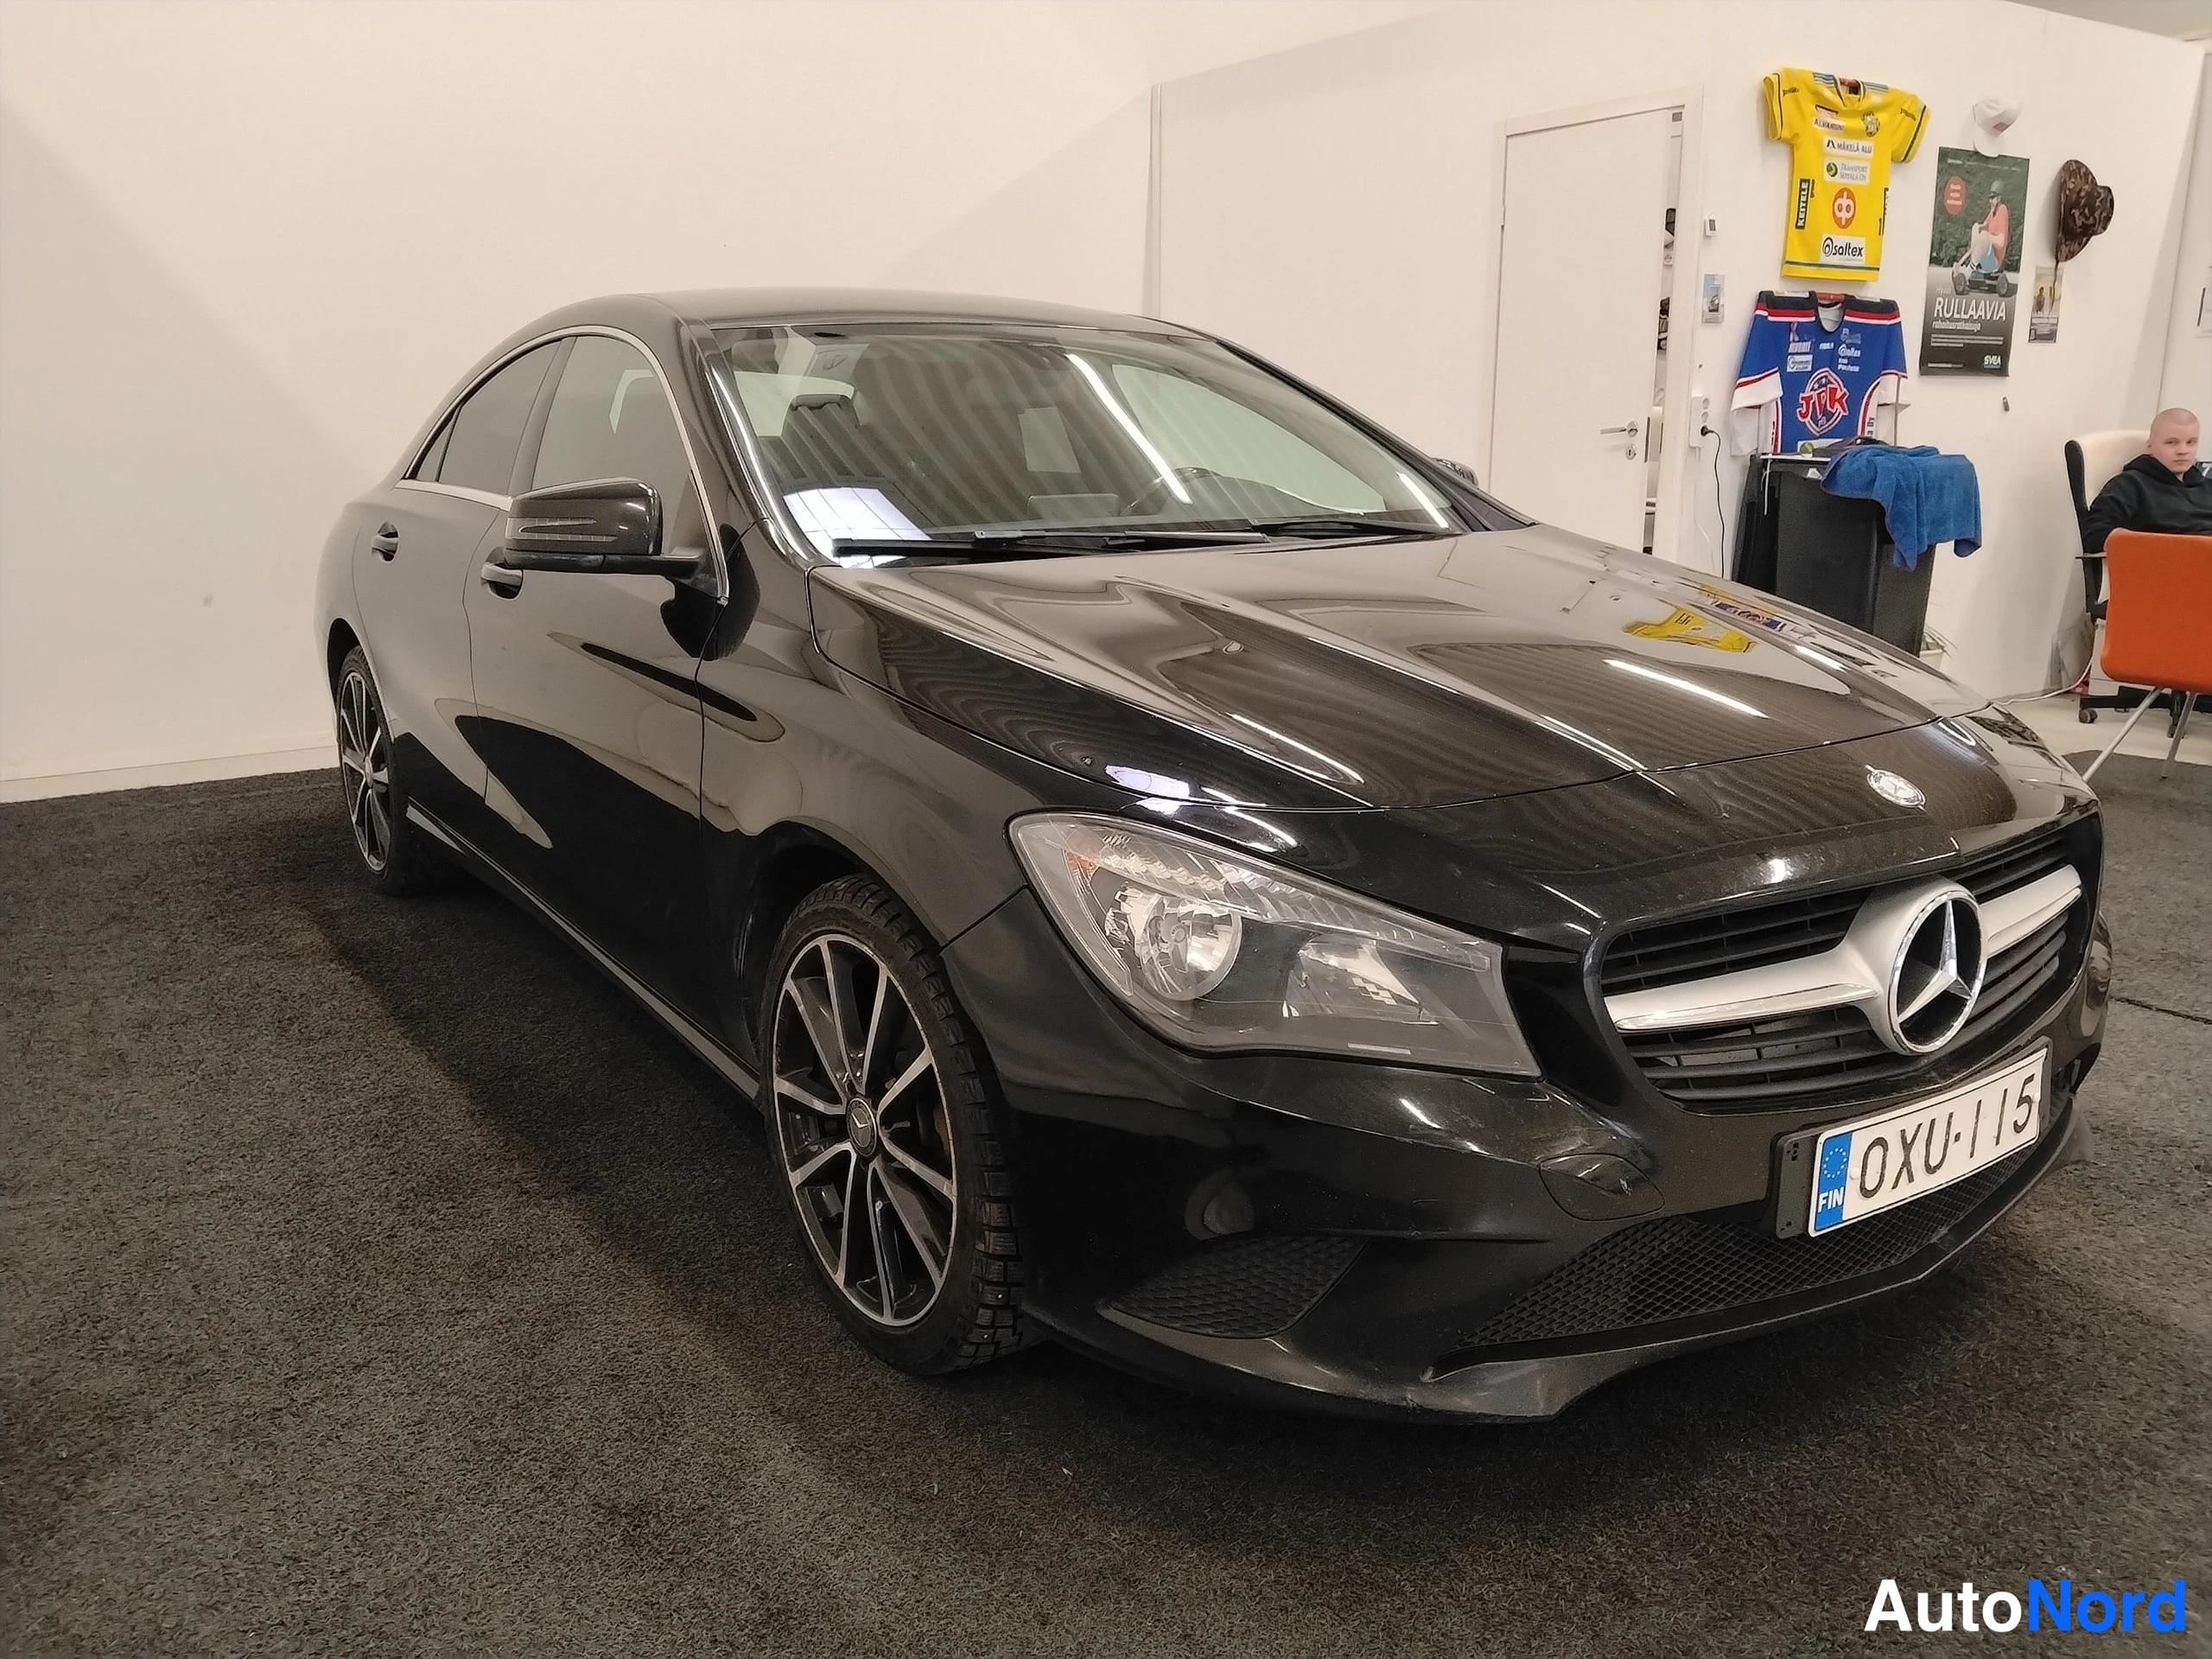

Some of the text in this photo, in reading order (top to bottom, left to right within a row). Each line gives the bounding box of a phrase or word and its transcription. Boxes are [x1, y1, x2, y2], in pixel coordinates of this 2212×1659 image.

[1797, 181, 1809, 227] KEITELE
[1832, 242, 1864, 257] saltex
[1934, 296, 2006, 321] RULLAAVIA
[1984, 354, 2001, 365] SVEA
[1859, 1072, 2036, 1199] OXU-115
[1818, 1186, 1845, 1213] FIN
